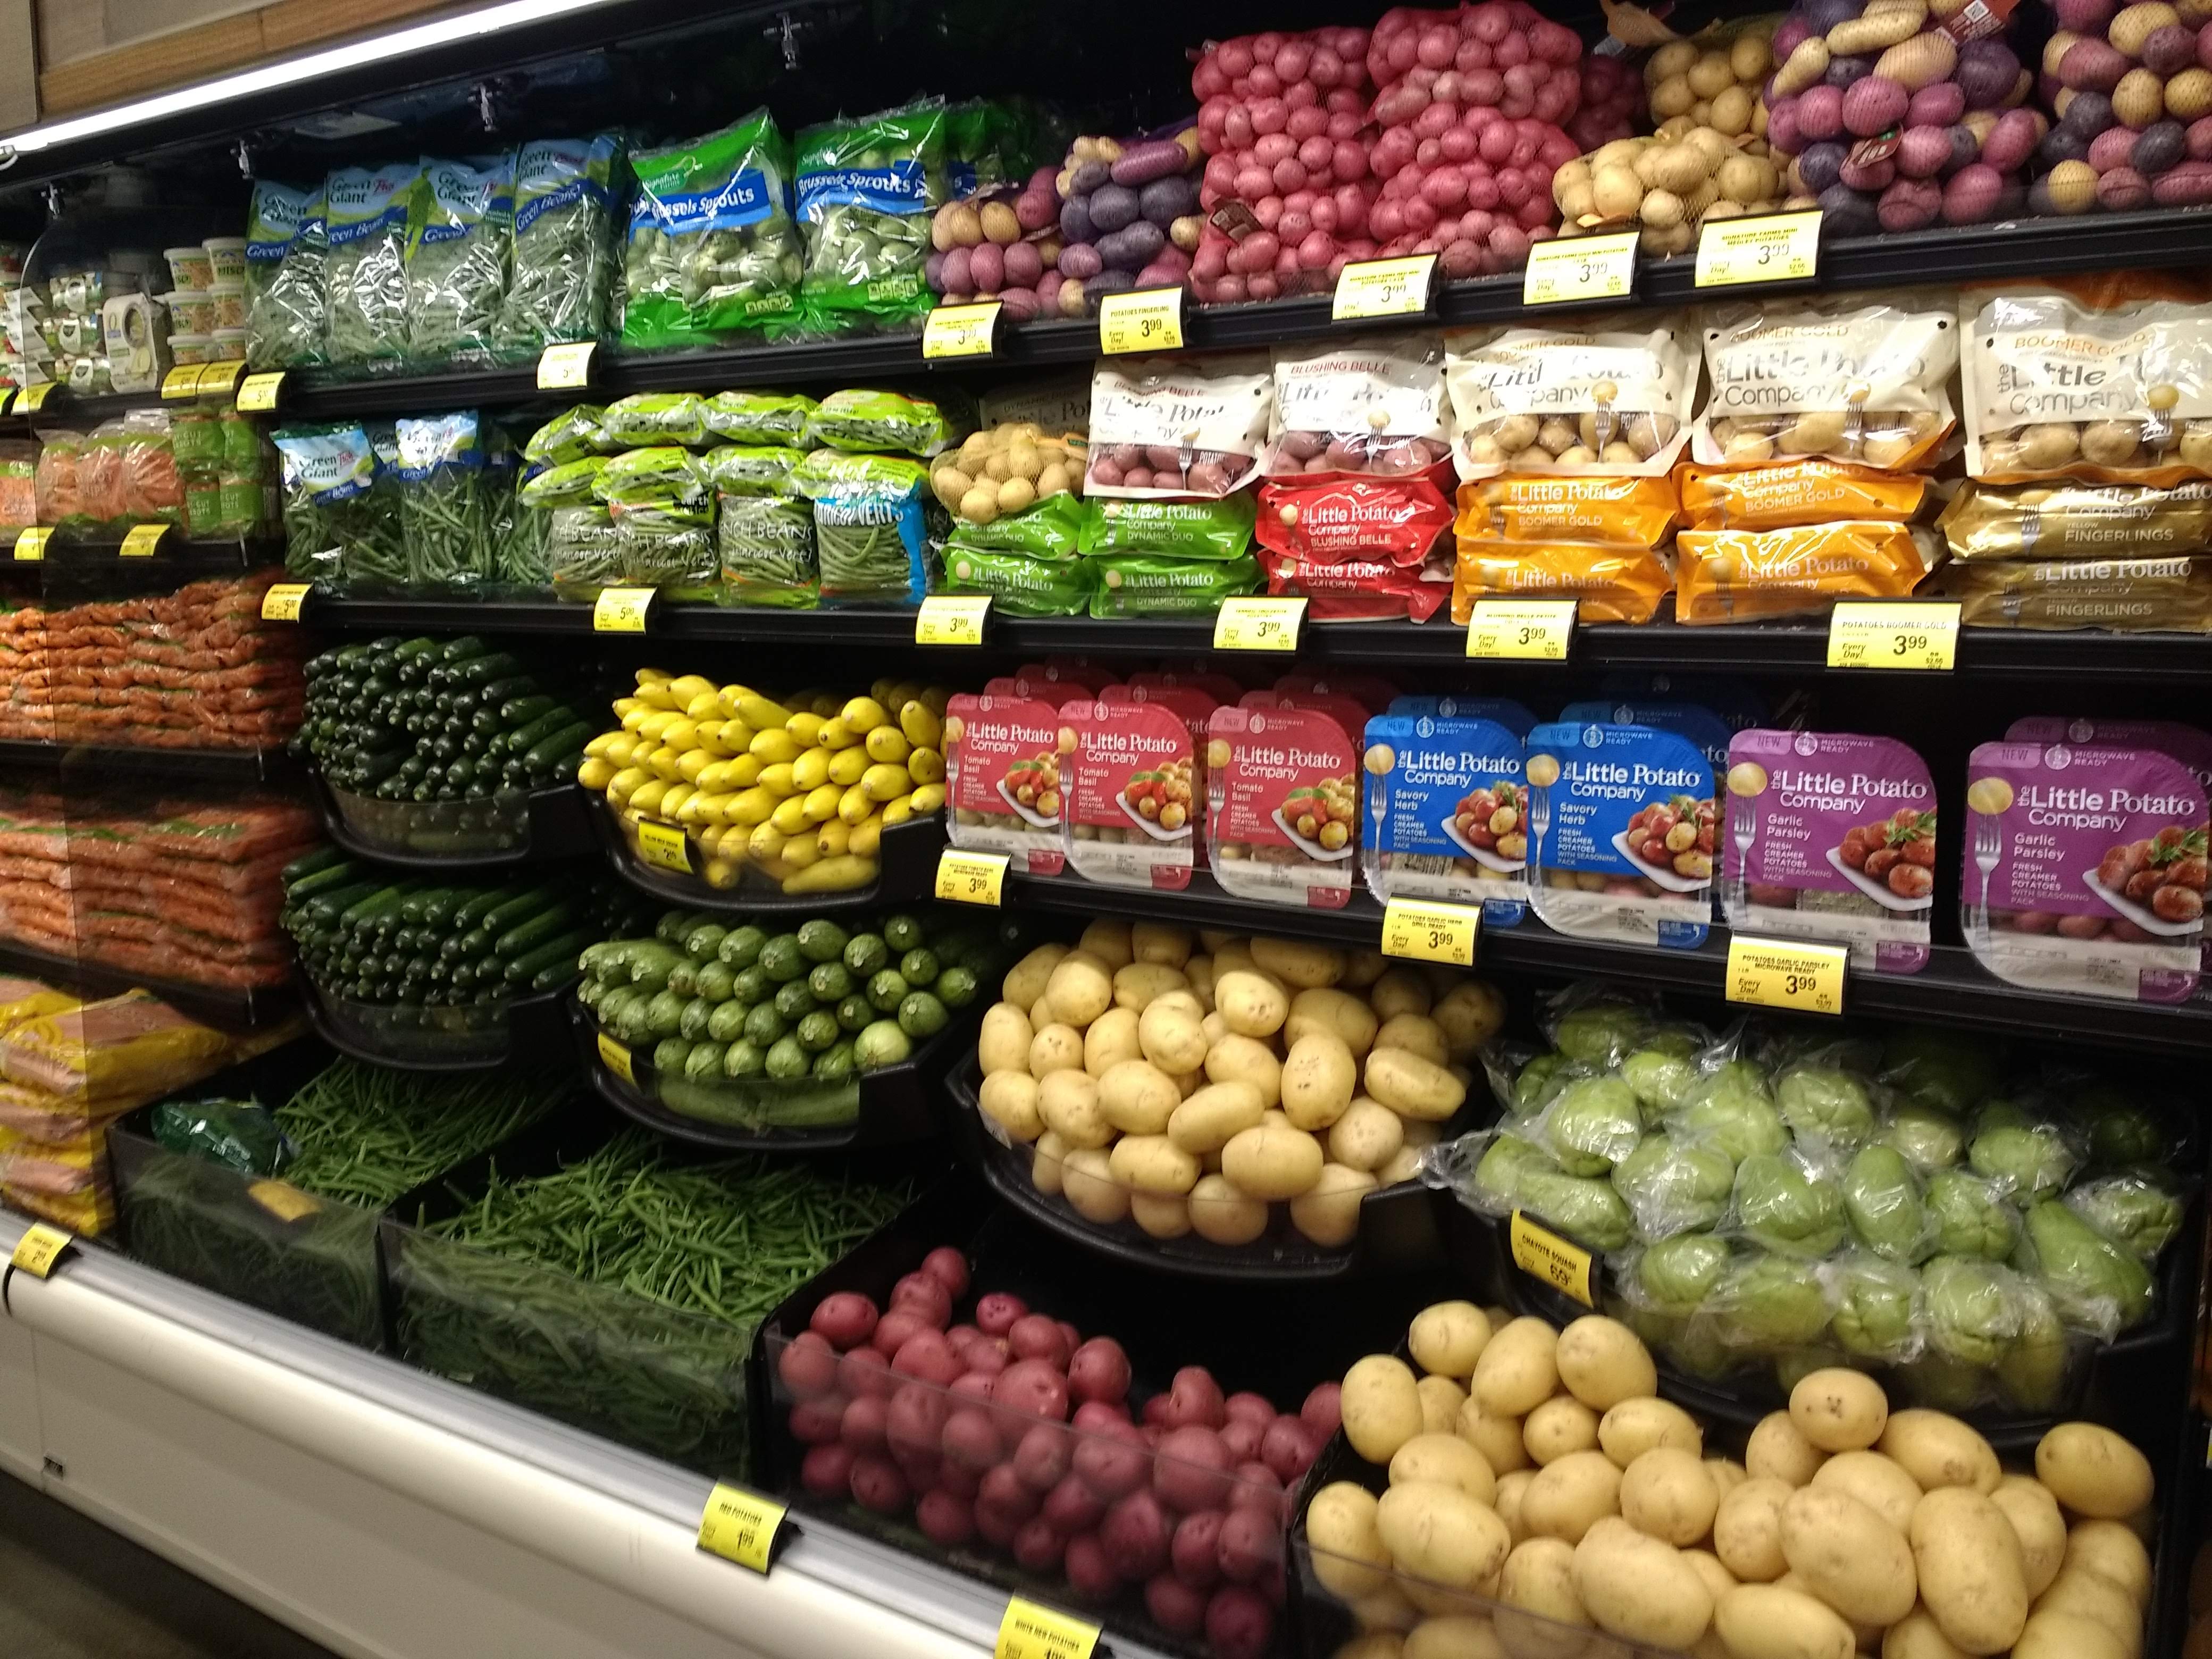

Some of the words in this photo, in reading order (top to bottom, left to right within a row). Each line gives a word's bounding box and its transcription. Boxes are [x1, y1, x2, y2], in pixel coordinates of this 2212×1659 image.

[333, 177, 371, 190] Green
[799, 173, 848, 197] Brussels
[847, 172, 910, 194] Sprouts
[330, 191, 367, 204] Giant
[699, 188, 755, 216] Sprouts
[516, 204, 538, 230] Green
[246, 244, 284, 258] Green
[1111, 308, 1137, 317] POTATOES
[1291, 362, 1347, 374] BLUSHING
[1728, 349, 1808, 383] Little
[1725, 384, 1836, 407] Company
[2010, 392, 2138, 415] Company
[299, 453, 337, 467] Green
[301, 467, 337, 479] Giant
[1518, 482, 1560, 502] Little
[1745, 492, 1795, 512] BOOMER
[1800, 488, 1845, 504] GOLD
[1166, 505, 1212, 520] Potato
[1309, 505, 1347, 523] Little
[1517, 501, 1578, 515] Company
[2066, 504, 2156, 520] Company
[1126, 519, 1176, 532] Company
[1519, 516, 1565, 526] BOOMER
[1568, 516, 1603, 526] GOLD
[758, 522, 811, 541] BEANS
[1309, 523, 1361, 539] Company
[2065, 529, 2174, 542] FINGERLINGS
[1311, 534, 1357, 547] BLUSHING
[1359, 533, 1392, 545] BELLE
[1305, 562, 1342, 577] Little
[1749, 557, 1799, 580] Little
[1805, 558, 1869, 574] Potato
[2046, 559, 2110, 581] Little
[2115, 560, 2191, 579] Potato
[1012, 572, 1053, 591] Potato
[1130, 573, 1167, 587] Little
[1170, 573, 1213, 586] Potato
[1512, 568, 1555, 588] Little
[1561, 572, 1615, 588] Potato
[2046, 605, 2152, 616] FINGERLINGS
[1842, 643, 1866, 652] Every
[1844, 650, 1863, 659] Day!
[973, 721, 1008, 739] Little
[1010, 724, 1053, 743] Potato
[1550, 731, 1570, 740] NEW
[971, 739, 1019, 755] Company
[1087, 732, 1126, 750] Little
[1129, 735, 1176, 753] Potato
[1757, 737, 1780, 747] NEW
[1821, 739, 1874, 748] MICROWAVE
[964, 755, 990, 765] Tomato
[1086, 750, 1139, 766] Company
[1242, 744, 1283, 765] Little
[1288, 749, 1340, 769] Potato
[2002, 749, 2028, 760] NEW
[2075, 750, 2136, 760] MICROWAVE
[963, 764, 979, 773] Basil
[1407, 750, 1455, 771] Little
[1459, 752, 1520, 775] Potato
[1079, 766, 1109, 777] Tomato
[1239, 764, 1299, 781] Company
[1573, 761, 1628, 784] Little
[1632, 764, 1700, 787] Potato
[1079, 776, 1096, 786] Basil
[1404, 770, 1471, 788] Company
[1782, 770, 1846, 794] Little
[1850, 773, 1926, 799] Potato
[1231, 782, 1263, 793] Tomato
[1571, 782, 1646, 802] Company
[1231, 792, 1251, 802] Basil
[1395, 790, 1429, 803] Savory
[1780, 793, 1865, 814] Company
[2032, 785, 2104, 811] Little
[2108, 788, 2196, 815] Potato
[1395, 801, 1418, 811] Herb
[1560, 802, 1597, 816] Savory
[1559, 814, 1585, 825] Herb
[1768, 813, 1803, 827] Garlic
[2029, 809, 2127, 832] Company
[1766, 826, 1811, 842] Parsley
[2015, 832, 2055, 847] Garlic
[1765, 842, 1791, 850] FRESH
[1765, 851, 1804, 860] CREAMER
[2013, 845, 2065, 862] Parsley
[1764, 858, 1807, 868] POTATOES
[2013, 862, 2042, 872] FRESH
[2012, 873, 2057, 882] CREAMER
[2012, 881, 2061, 891] POTATOES
[1398, 914, 1425, 922] POTATOES
[1392, 934, 1409, 943] Every
[1393, 941, 1407, 949] Day!
[1742, 955, 1775, 963] POTATOES
[1755, 963, 1792, 973] MICROWAVE
[1739, 978, 1761, 987] Every
[1740, 985, 1758, 994] Day!
[1522, 1234, 1549, 1258] CHAYOTE
[1552, 1251, 1577, 1273] SQUASH
[732, 1505, 762, 1528] POTATOES
